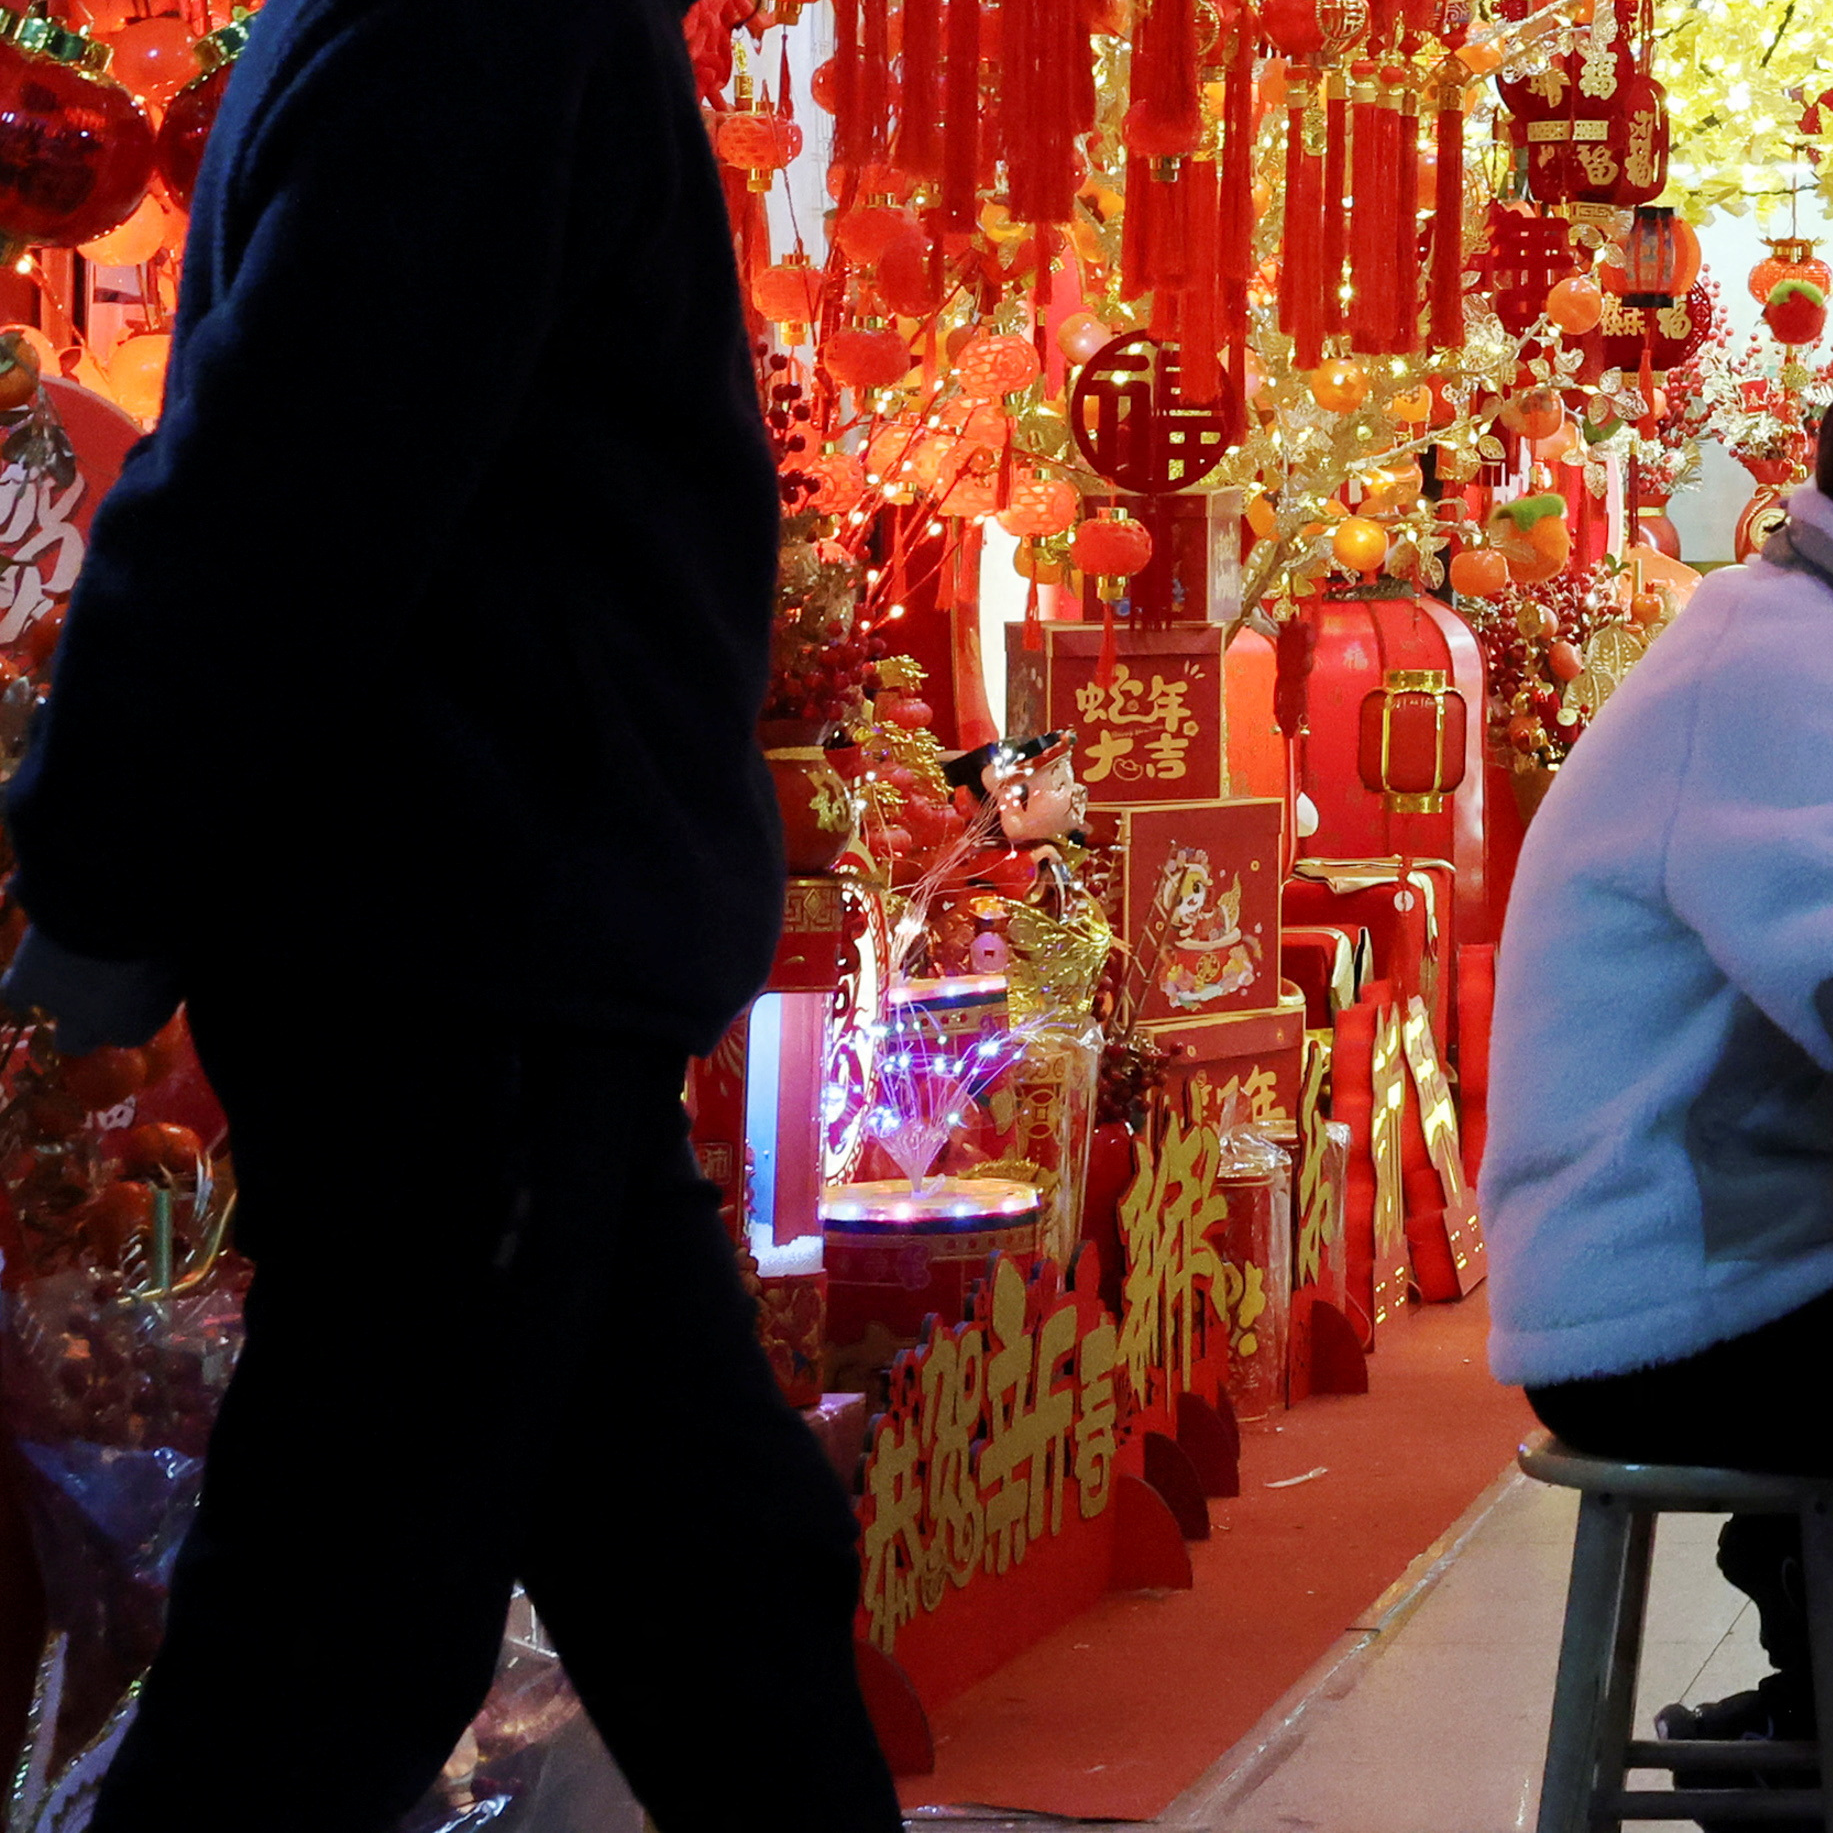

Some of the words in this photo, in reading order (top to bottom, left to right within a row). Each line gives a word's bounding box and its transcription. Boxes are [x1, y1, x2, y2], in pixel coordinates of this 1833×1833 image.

[1656, 295, 1692, 340] 福
[1078, 337, 1238, 487] 福
[1075, 661, 1195, 737] 蛇年
[1083, 735, 1191, 781] 大吉
